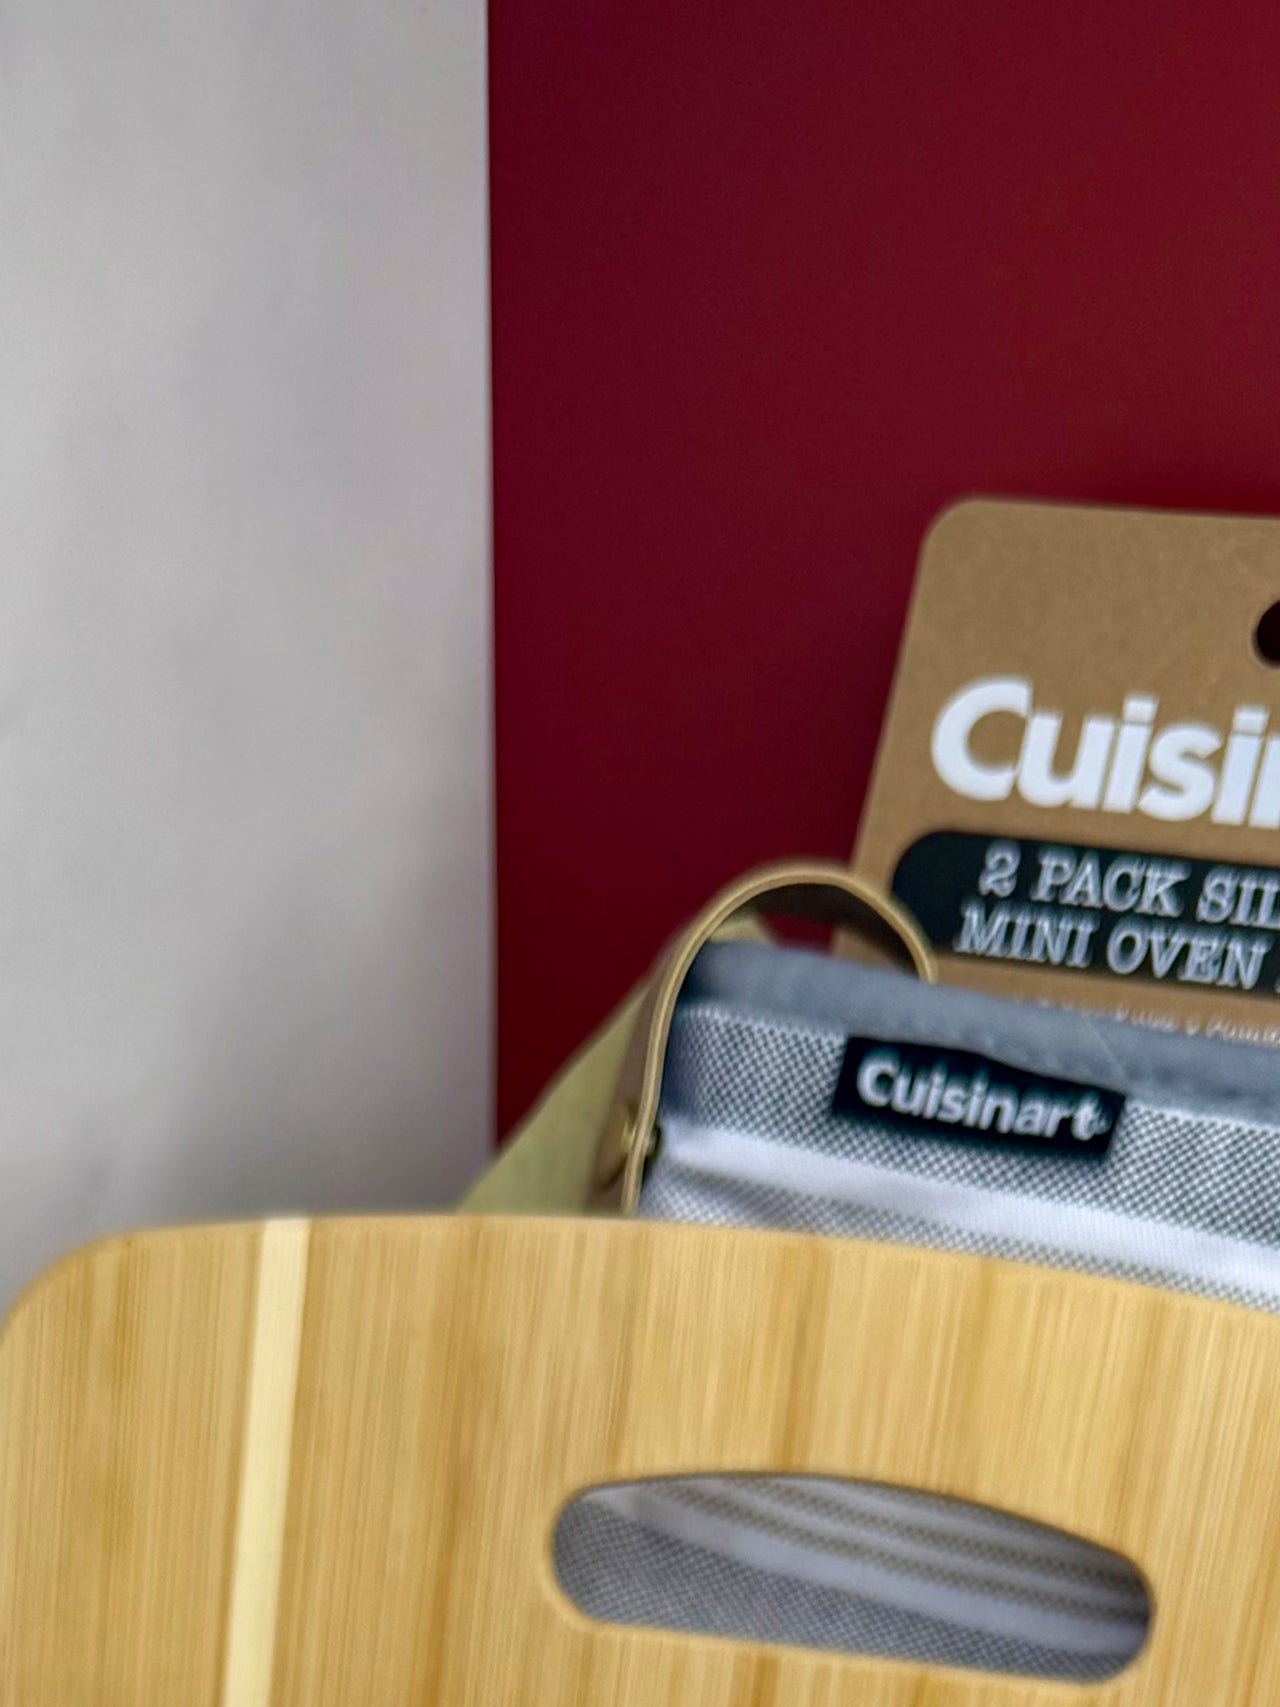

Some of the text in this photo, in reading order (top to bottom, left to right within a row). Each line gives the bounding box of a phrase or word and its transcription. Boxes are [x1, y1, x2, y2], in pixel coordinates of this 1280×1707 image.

[978, 840, 1020, 897] 2
[1031, 847, 1187, 919] PACK
[953, 907, 1095, 969] MINI
[1106, 926, 1266, 990] OVEN
[856, 1047, 1104, 1141] Cuisinart
